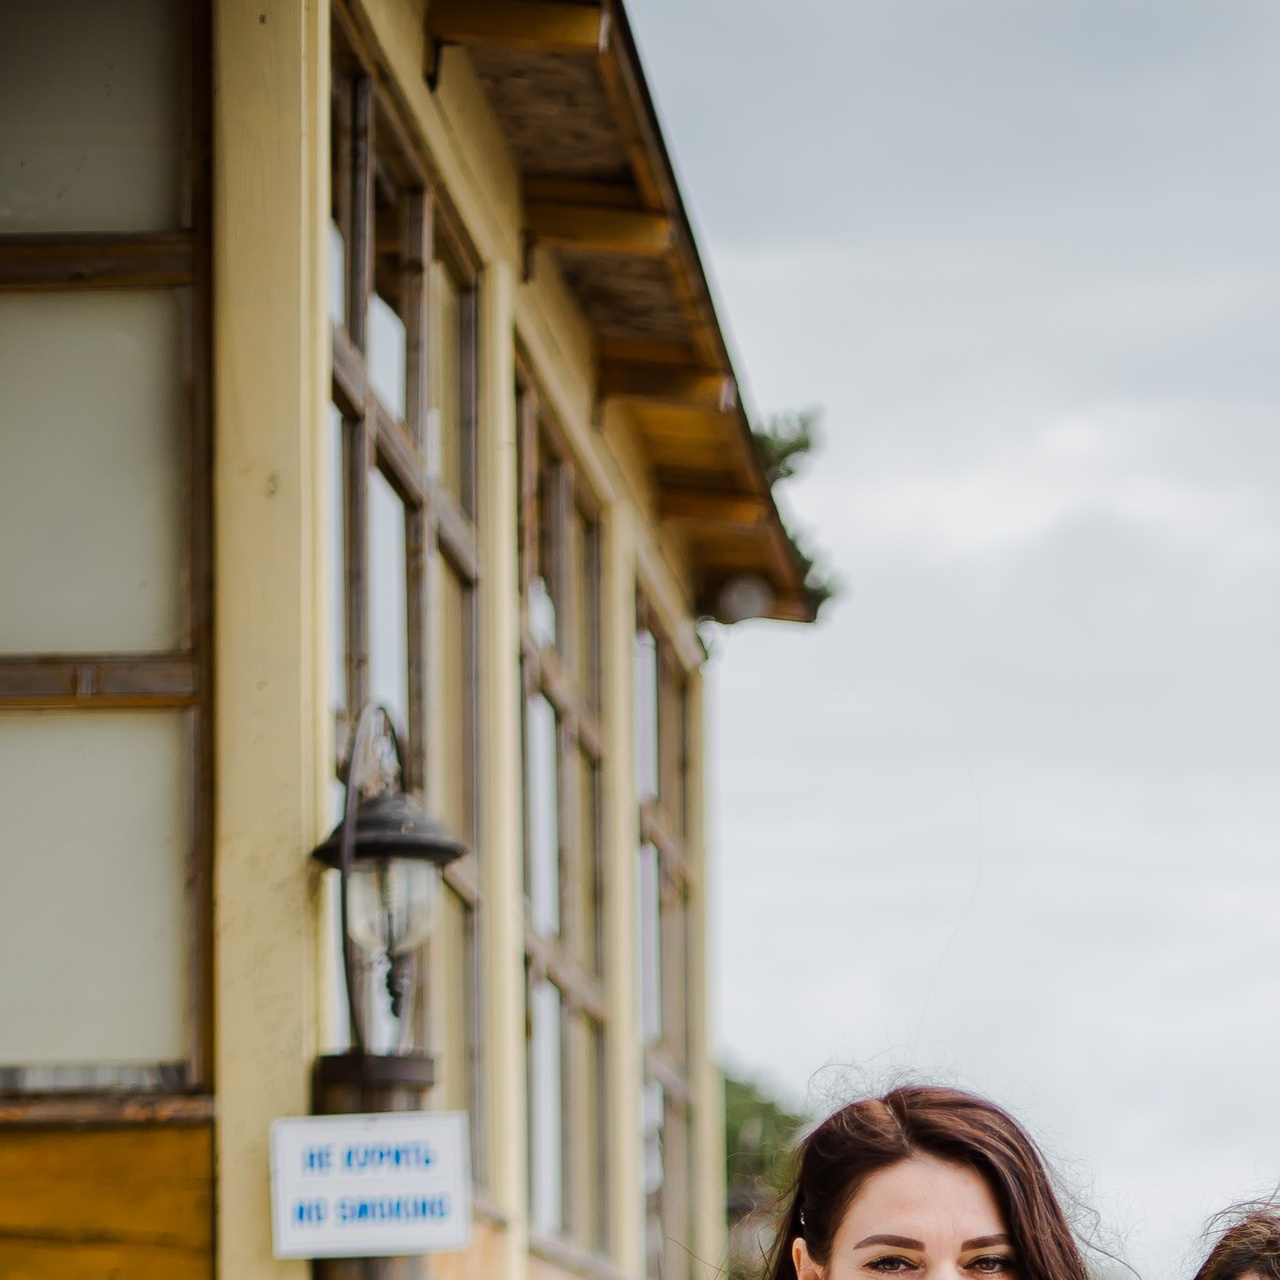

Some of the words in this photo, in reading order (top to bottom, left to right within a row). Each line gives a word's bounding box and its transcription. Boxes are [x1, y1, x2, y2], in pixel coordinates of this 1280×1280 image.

[303, 1145, 333, 1172] НЕ
[342, 1141, 435, 1170] КУРИТЬ
[292, 1198, 325, 1226] NO
[336, 1194, 450, 1223] SMOKING
